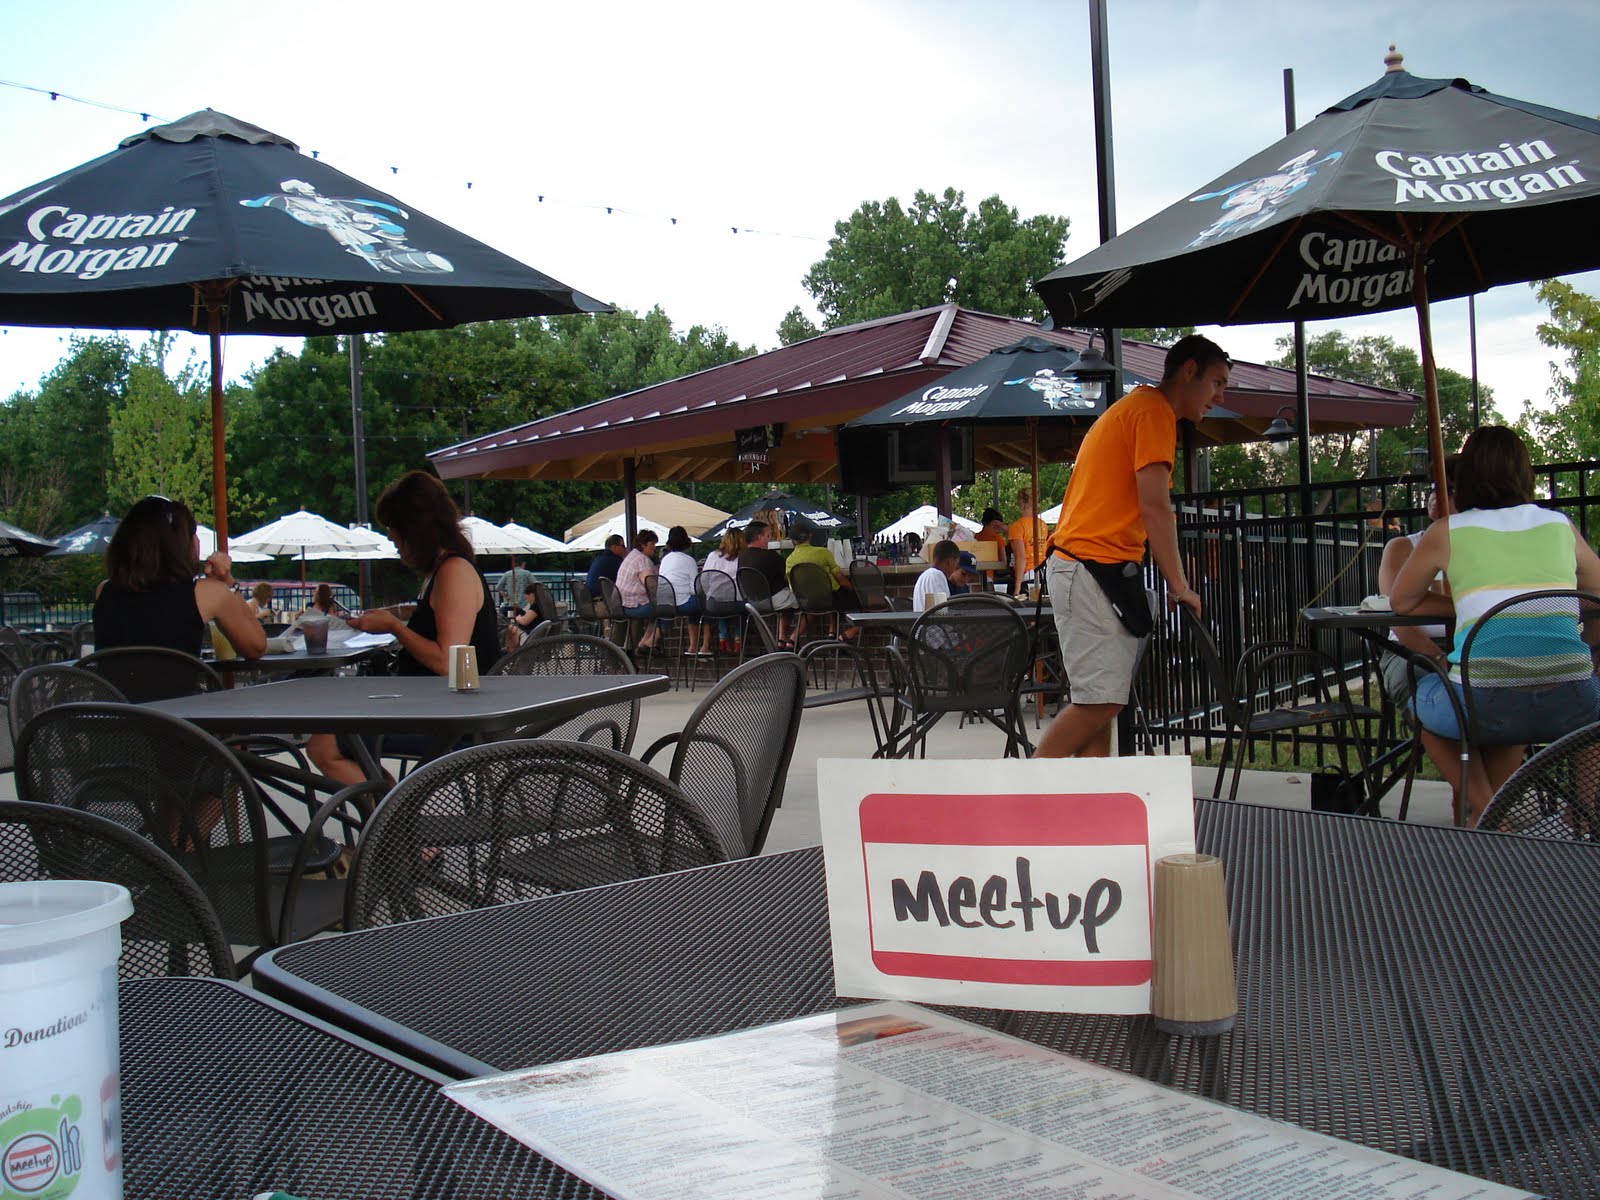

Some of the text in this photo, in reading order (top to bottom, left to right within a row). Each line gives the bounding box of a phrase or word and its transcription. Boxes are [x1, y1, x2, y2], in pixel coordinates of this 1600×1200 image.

[1375, 139, 1557, 181] Captain
[1395, 165, 1588, 204] Morgan
[27, 205, 197, 245] Captain
[0, 241, 179, 280] Morgan
[1300, 232, 1406, 272] Capta
[241, 289, 378, 327] Morgan
[890, 400, 971, 416] Morgan
[922, 384, 989, 401] Captain
[4, 1010, 88, 1049] Donations
